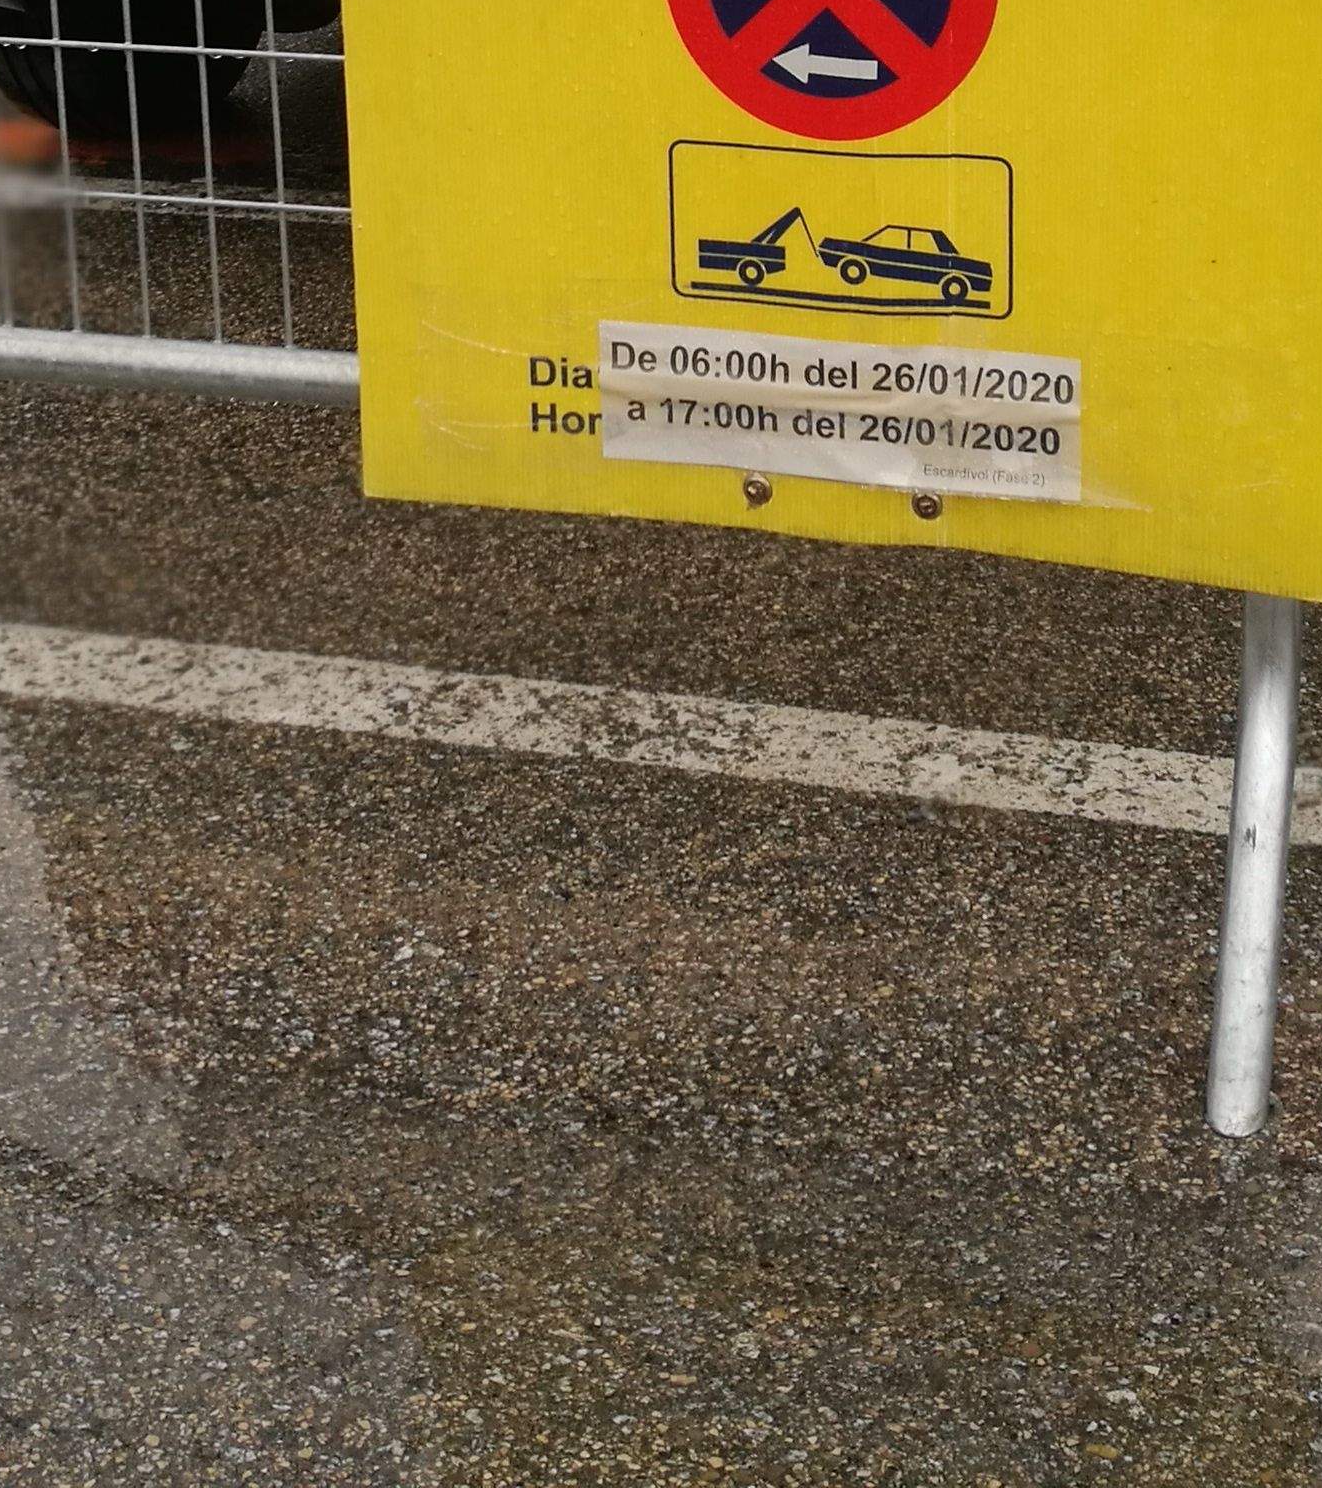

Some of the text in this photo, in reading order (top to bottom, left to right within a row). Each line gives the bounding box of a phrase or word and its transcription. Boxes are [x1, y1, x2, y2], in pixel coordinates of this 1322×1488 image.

[611, 341, 1075, 405] De 06:00h del 26/01/2020
[627, 397, 1061, 456] a 17:00h del 26/01/2020
